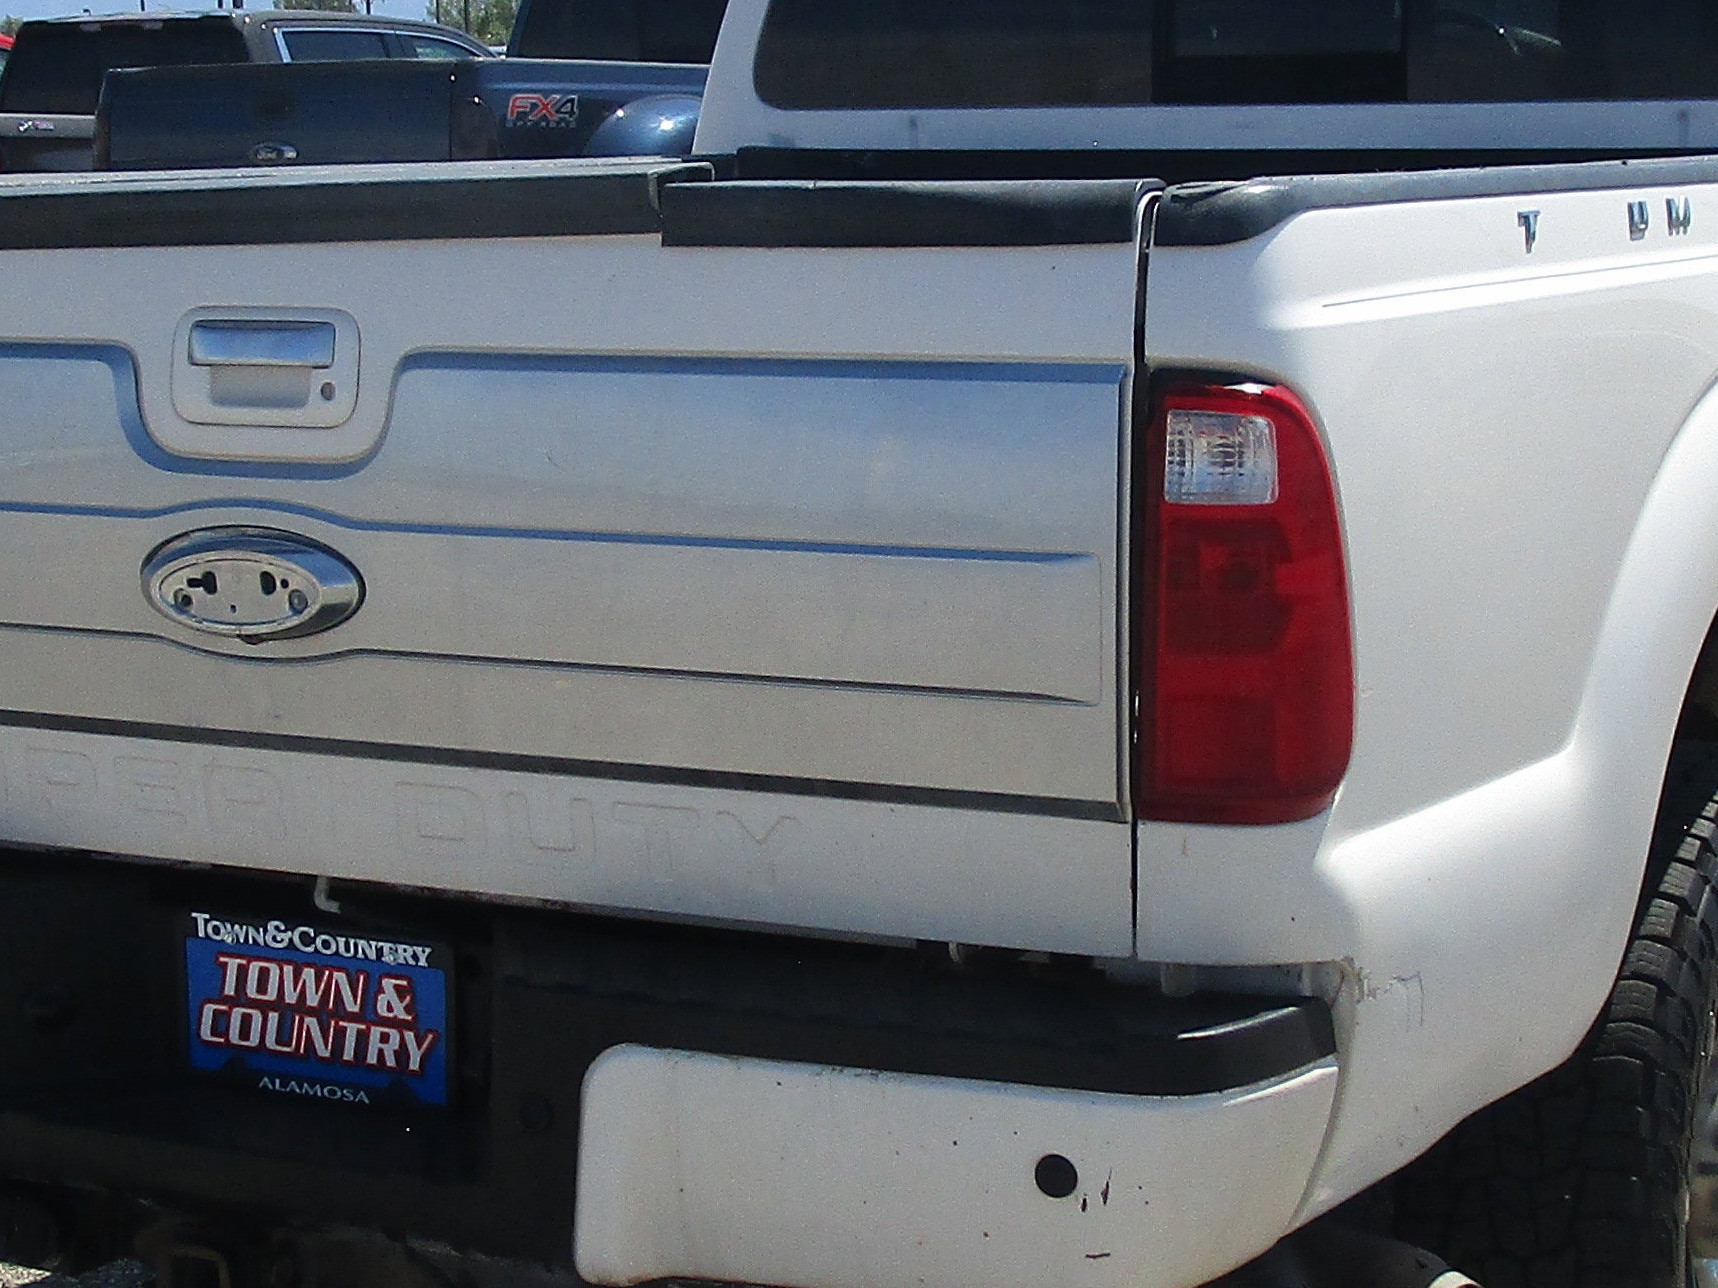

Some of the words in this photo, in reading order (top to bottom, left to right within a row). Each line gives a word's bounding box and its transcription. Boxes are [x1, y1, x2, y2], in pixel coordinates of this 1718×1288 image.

[507, 94, 578, 120] FX4
[394, 779, 802, 882] DUTY
[217, 955, 366, 1014] TOWN
[376, 977, 413, 1022] &
[199, 1002, 434, 1073] COUNTRY
[258, 1076, 370, 1105] ALAMOSA
